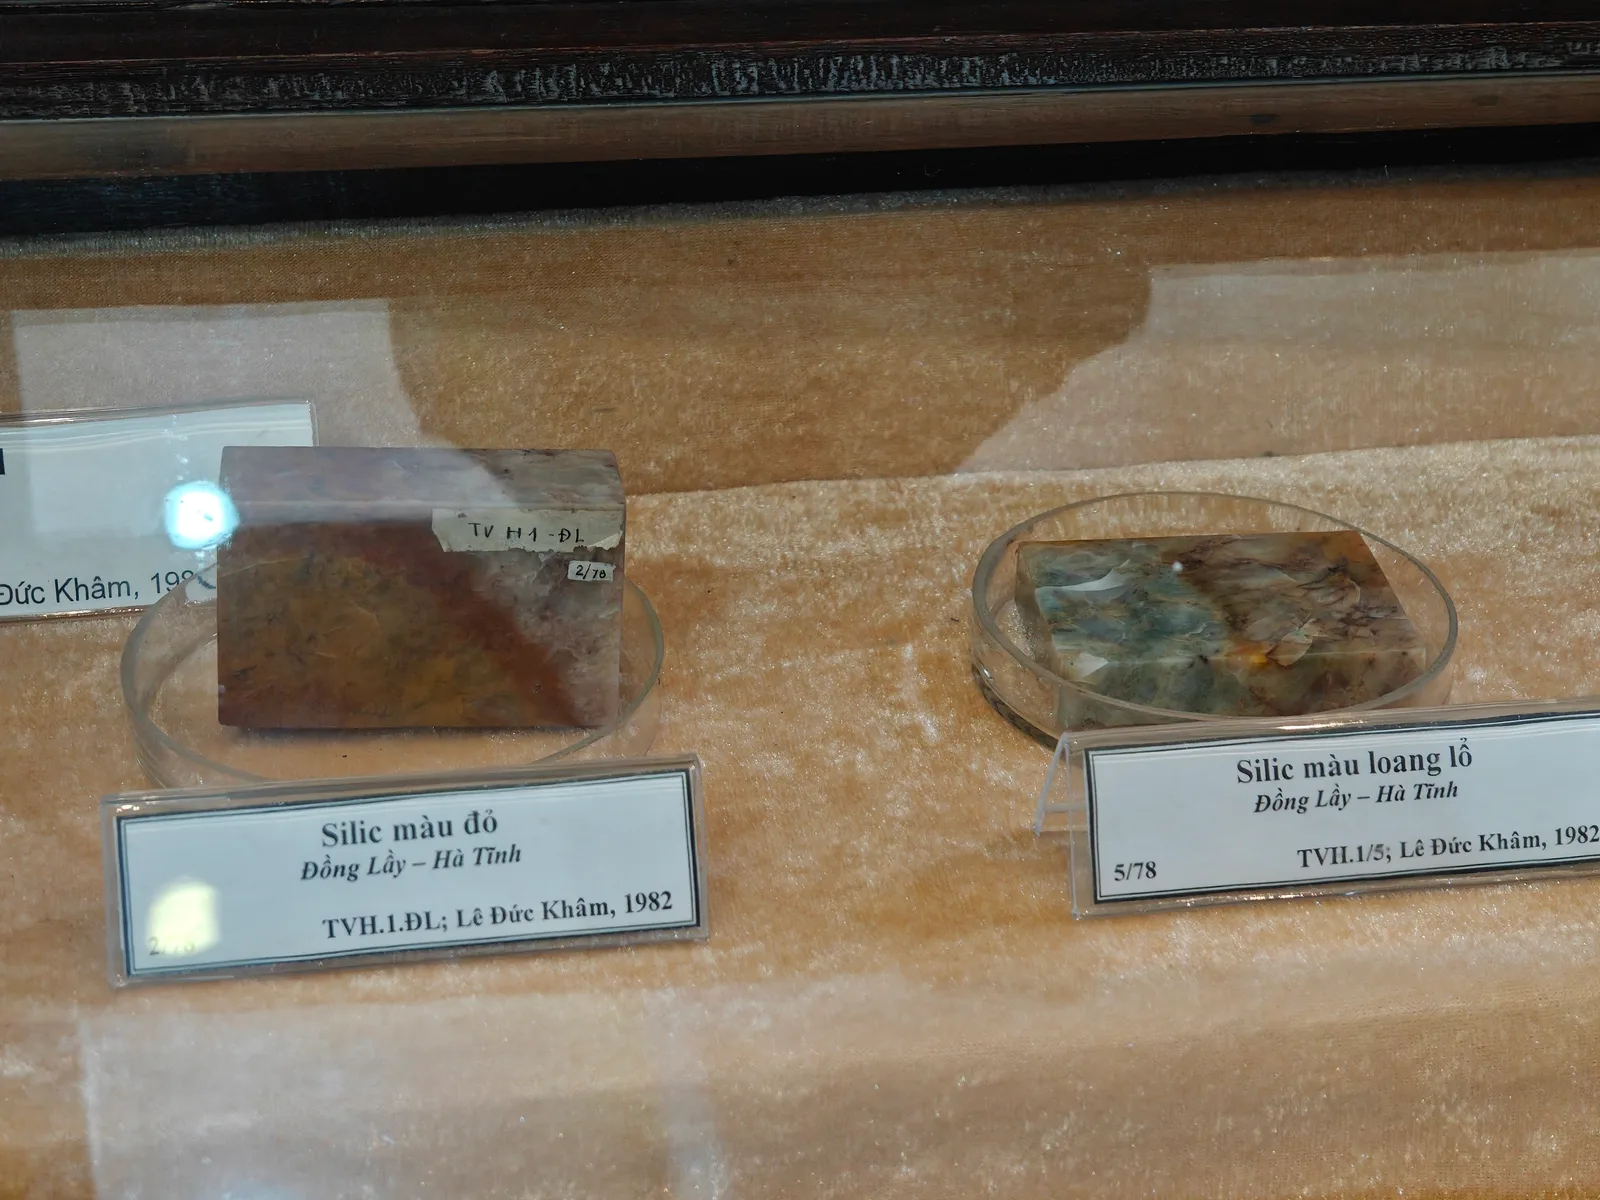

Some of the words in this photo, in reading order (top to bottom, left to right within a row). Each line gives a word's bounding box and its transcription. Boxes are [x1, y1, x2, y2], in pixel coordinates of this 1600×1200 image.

[54, 576, 139, 603] Khâm,
[1236, 758, 1294, 785] Silic
[1303, 754, 1360, 779] màu
[1368, 749, 1443, 777] loang
[1449, 737, 1473, 769] lổ
[1254, 787, 1309, 815] Đồng
[1314, 783, 1352, 812] Lầy
[1375, 784, 1406, 804] Hà
[1413, 781, 1459, 801] Tĩnh
[321, 819, 382, 848] Silic
[393, 814, 454, 842] màu
[464, 808, 499, 836] đỏ
[1400, 840, 1425, 859] Lê
[1430, 836, 1473, 856] Đức
[1477, 830, 1547, 851] Khâm,
[1555, 824, 1600, 845] 1982
[300, 853, 361, 883] Đồng
[367, 848, 407, 878] Lầy
[432, 848, 464, 871] Hà
[472, 843, 522, 866] Tĩnh
[1114, 861, 1157, 881] 5/78
[322, 910, 448, 938] TVH.1.ĐL;
[457, 905, 483, 928] Lê
[489, 902, 534, 926] Đức
[541, 897, 616, 922] Khâm,
[624, 890, 674, 914] 1982
